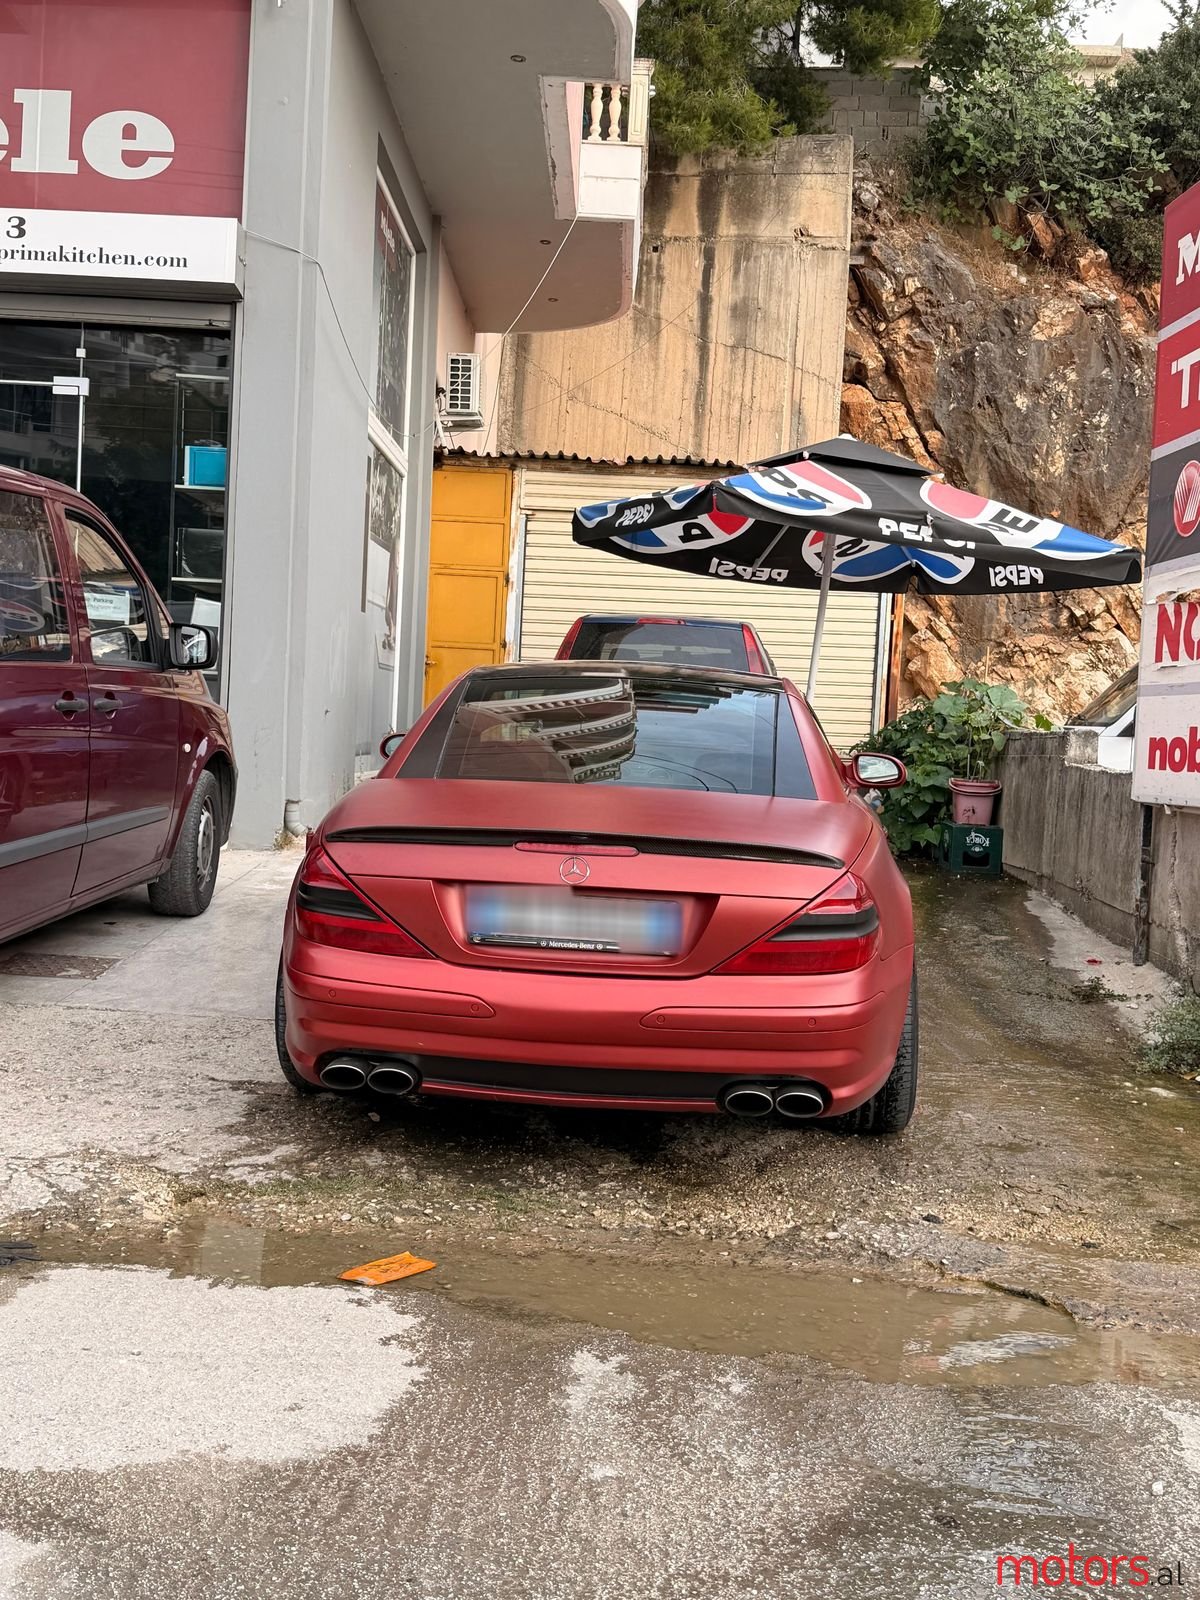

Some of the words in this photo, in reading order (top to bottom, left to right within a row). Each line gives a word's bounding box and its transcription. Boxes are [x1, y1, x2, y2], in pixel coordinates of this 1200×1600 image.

[0, 89, 175, 180] le
[6, 215, 27, 239] 3
[614, 502, 655, 528] PEPSI
[549, 941, 595, 950] Mercedes-Benz
